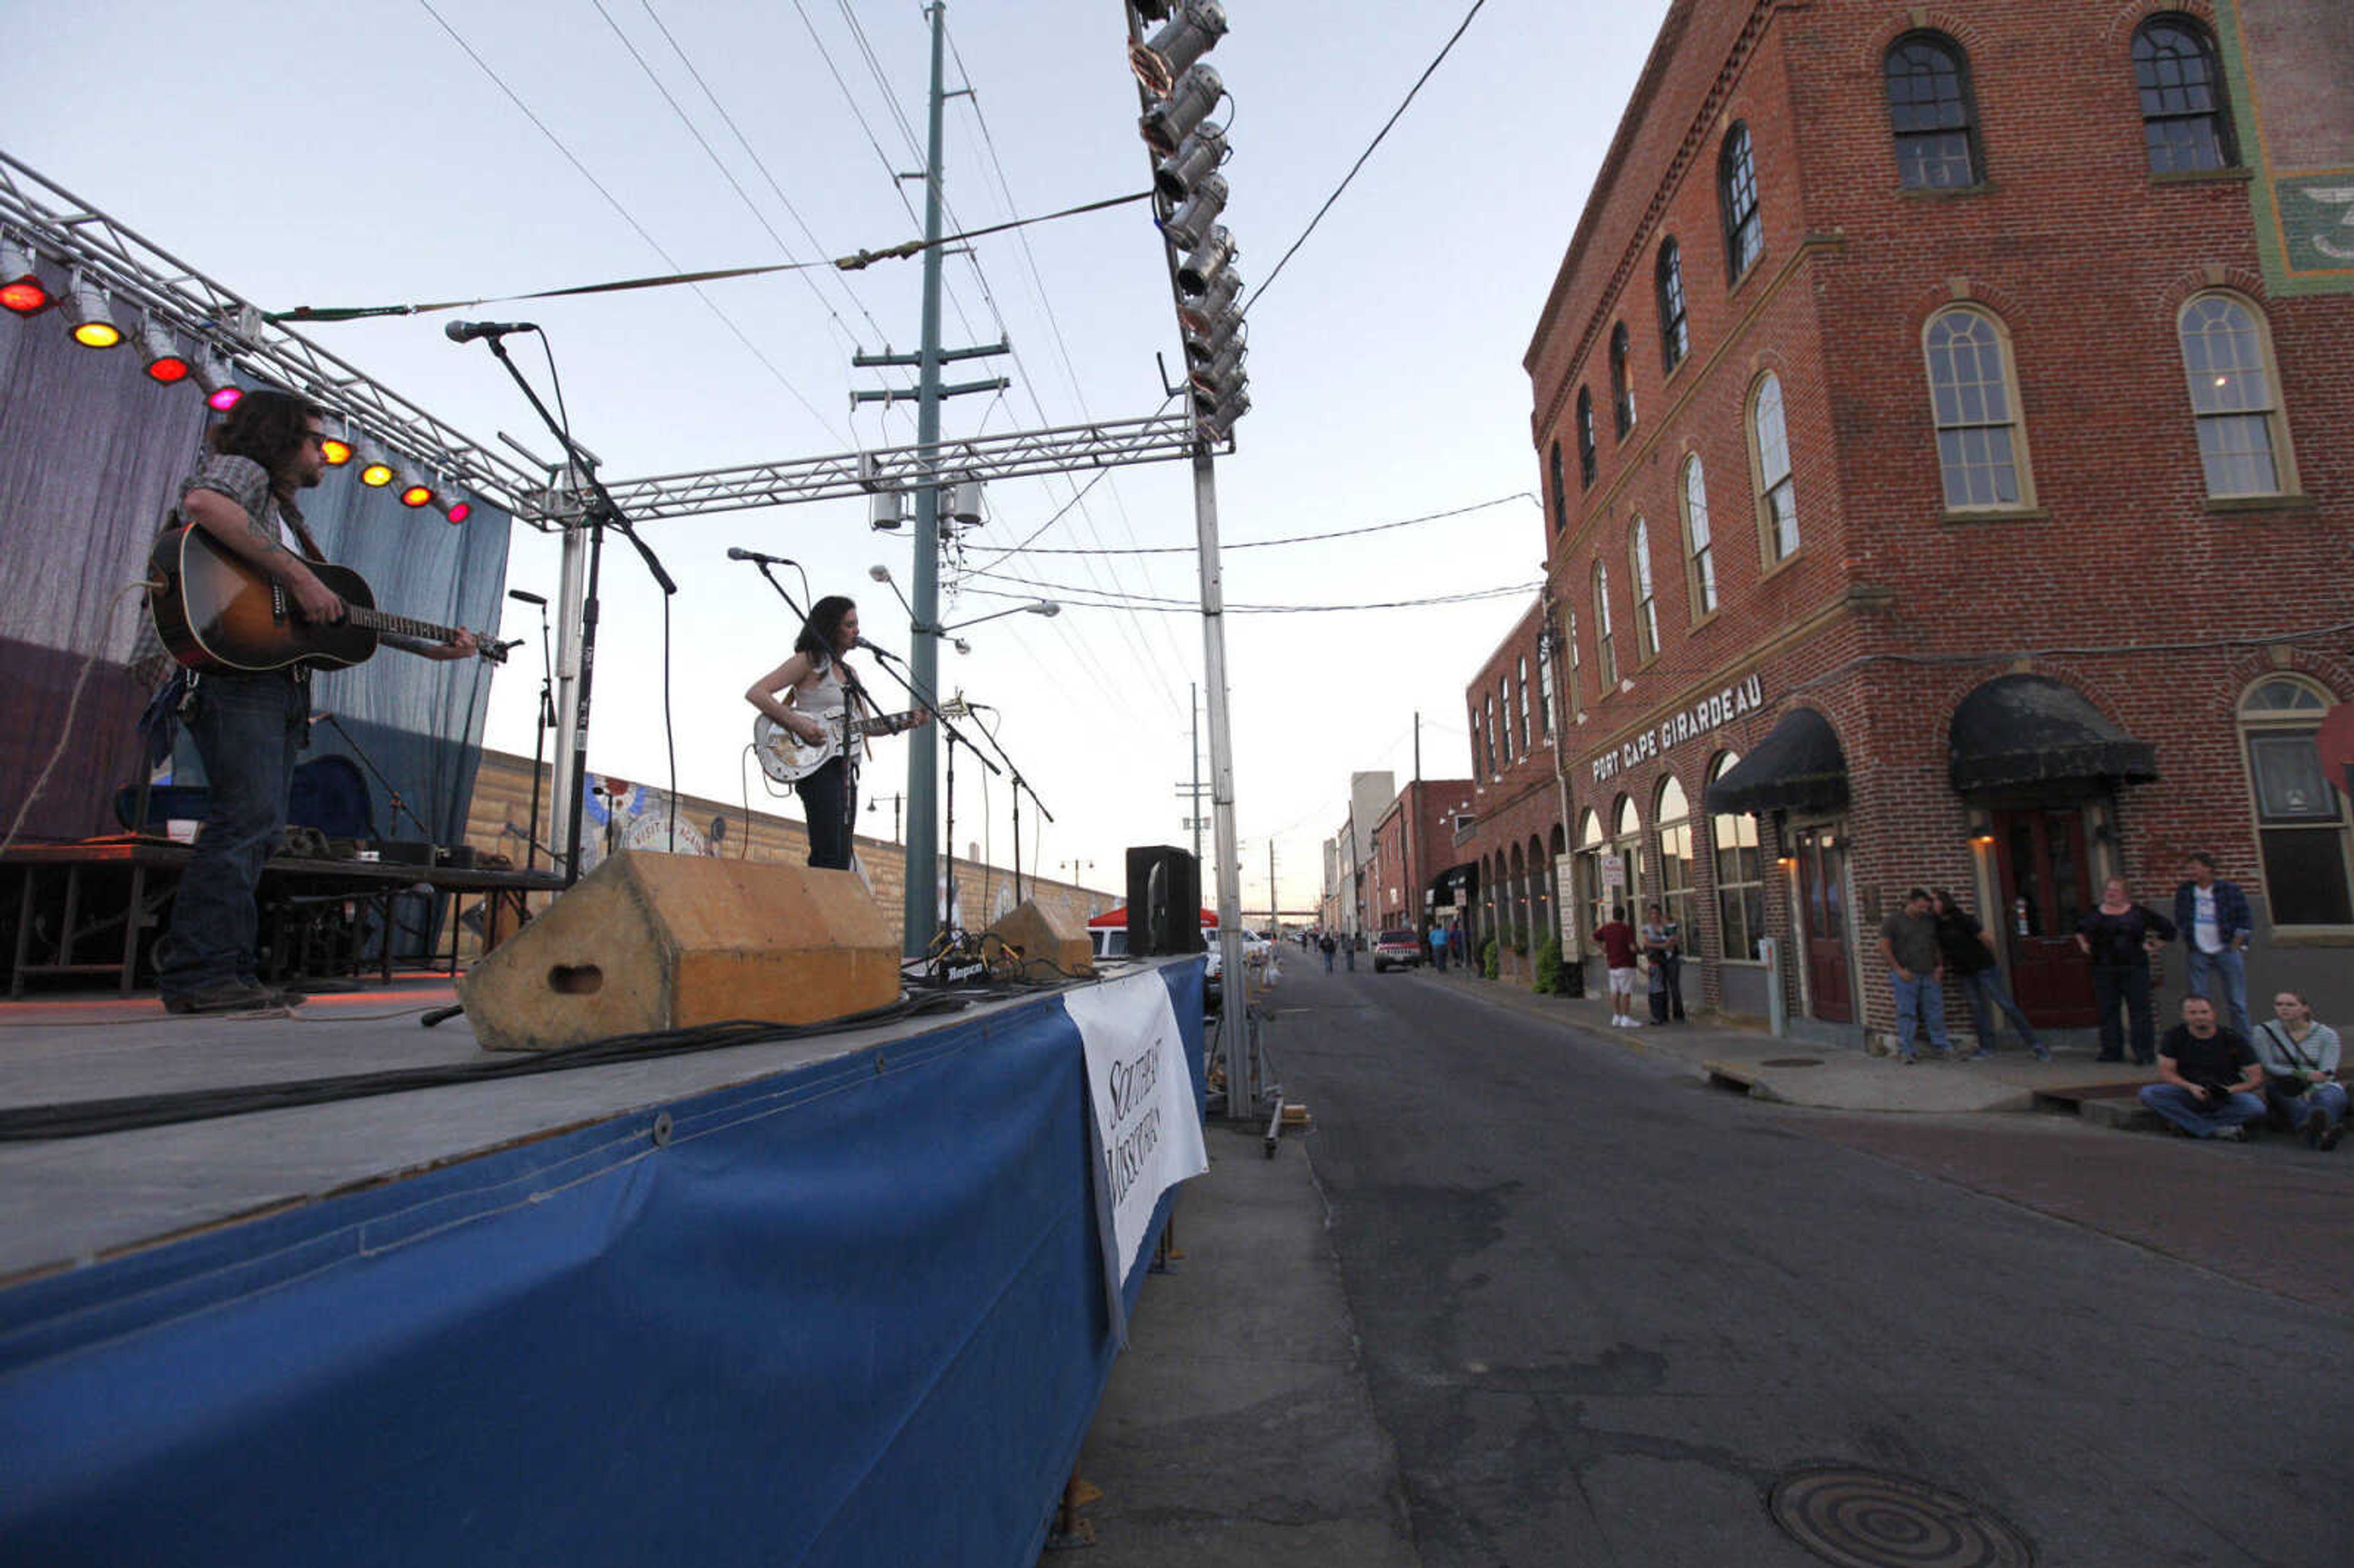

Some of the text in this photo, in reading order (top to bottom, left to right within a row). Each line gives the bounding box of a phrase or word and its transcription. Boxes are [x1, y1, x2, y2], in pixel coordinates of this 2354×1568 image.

[1592, 674, 1763, 783] PORT CAPE GIRARDEAU
